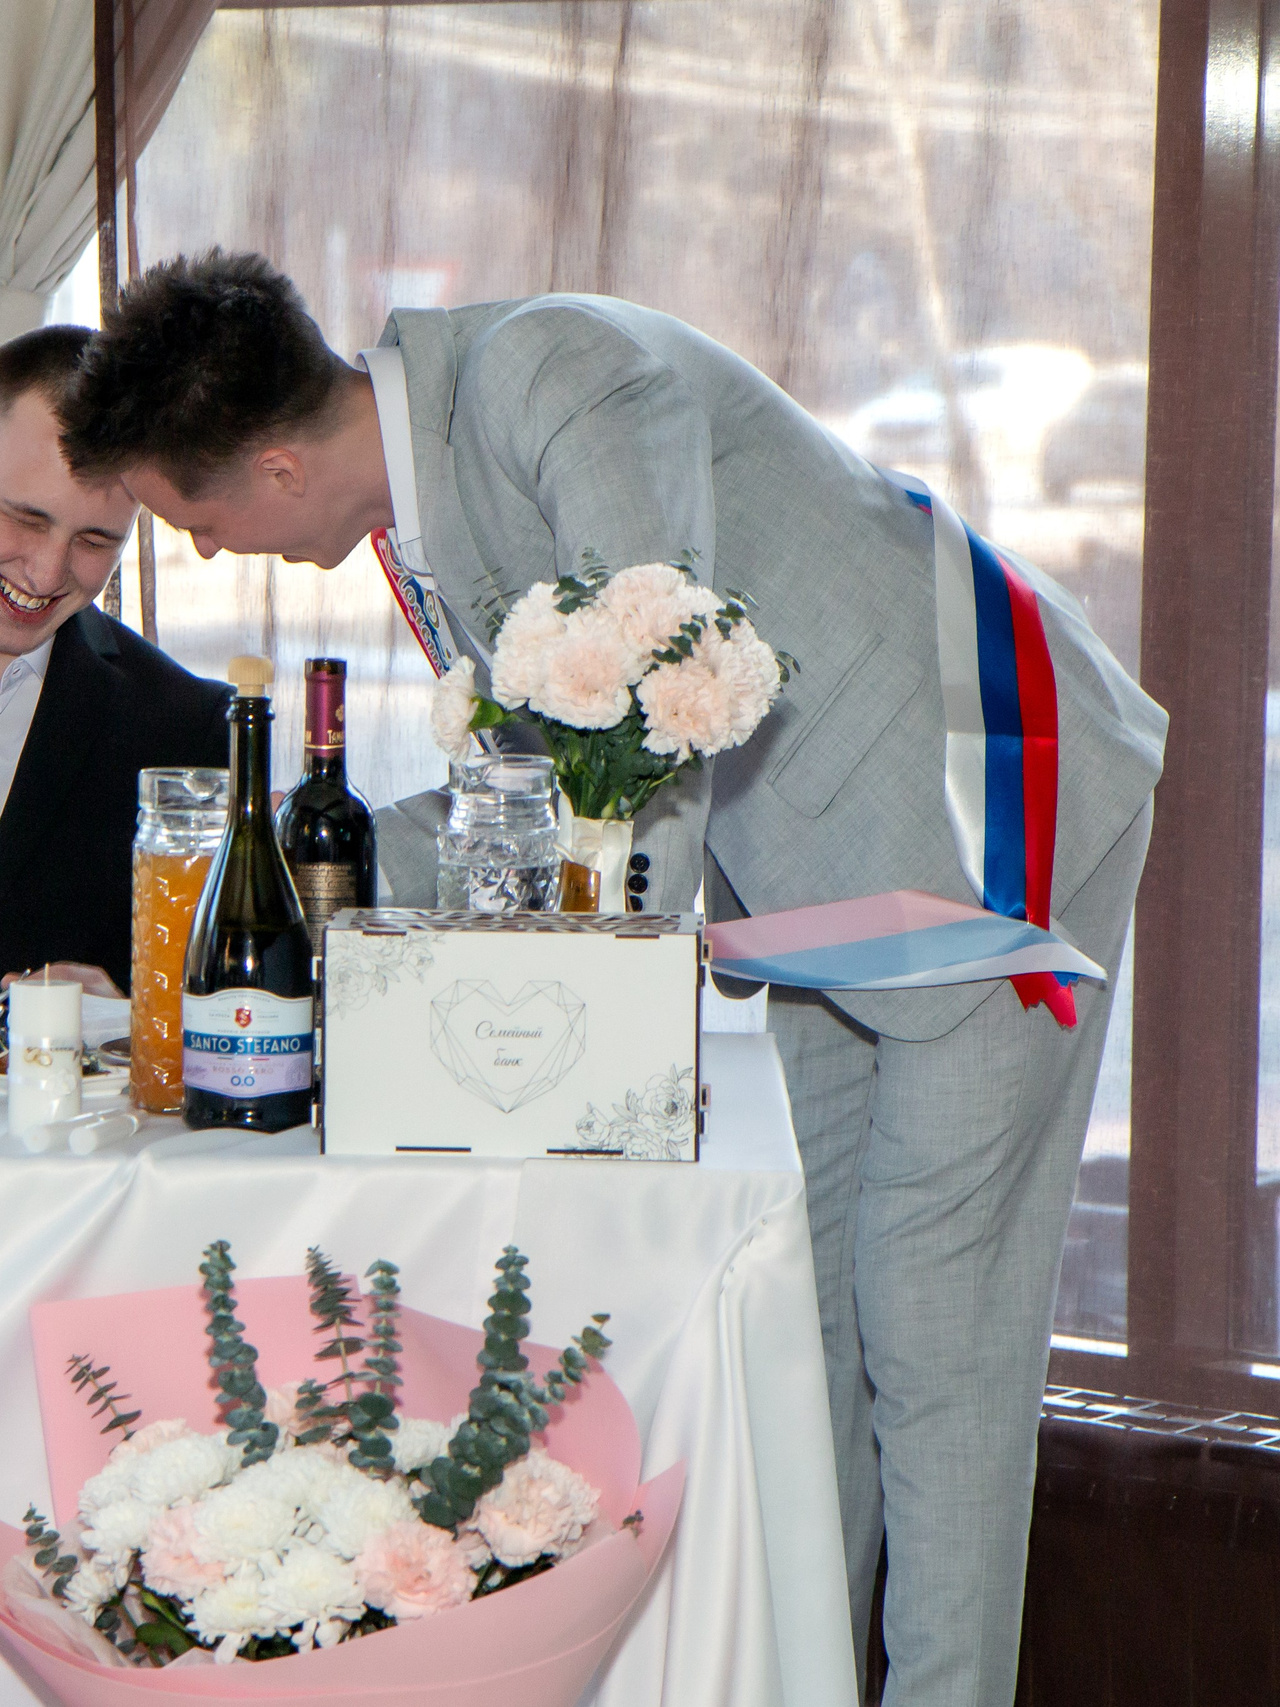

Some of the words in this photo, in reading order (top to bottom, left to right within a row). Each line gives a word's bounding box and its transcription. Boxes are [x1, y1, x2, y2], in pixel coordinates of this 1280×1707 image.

[475, 1020, 543, 1040] Семейный
[190, 1034, 231, 1053] SANTO
[237, 1037, 301, 1053] STEFANO
[493, 1047, 523, 1066] банк
